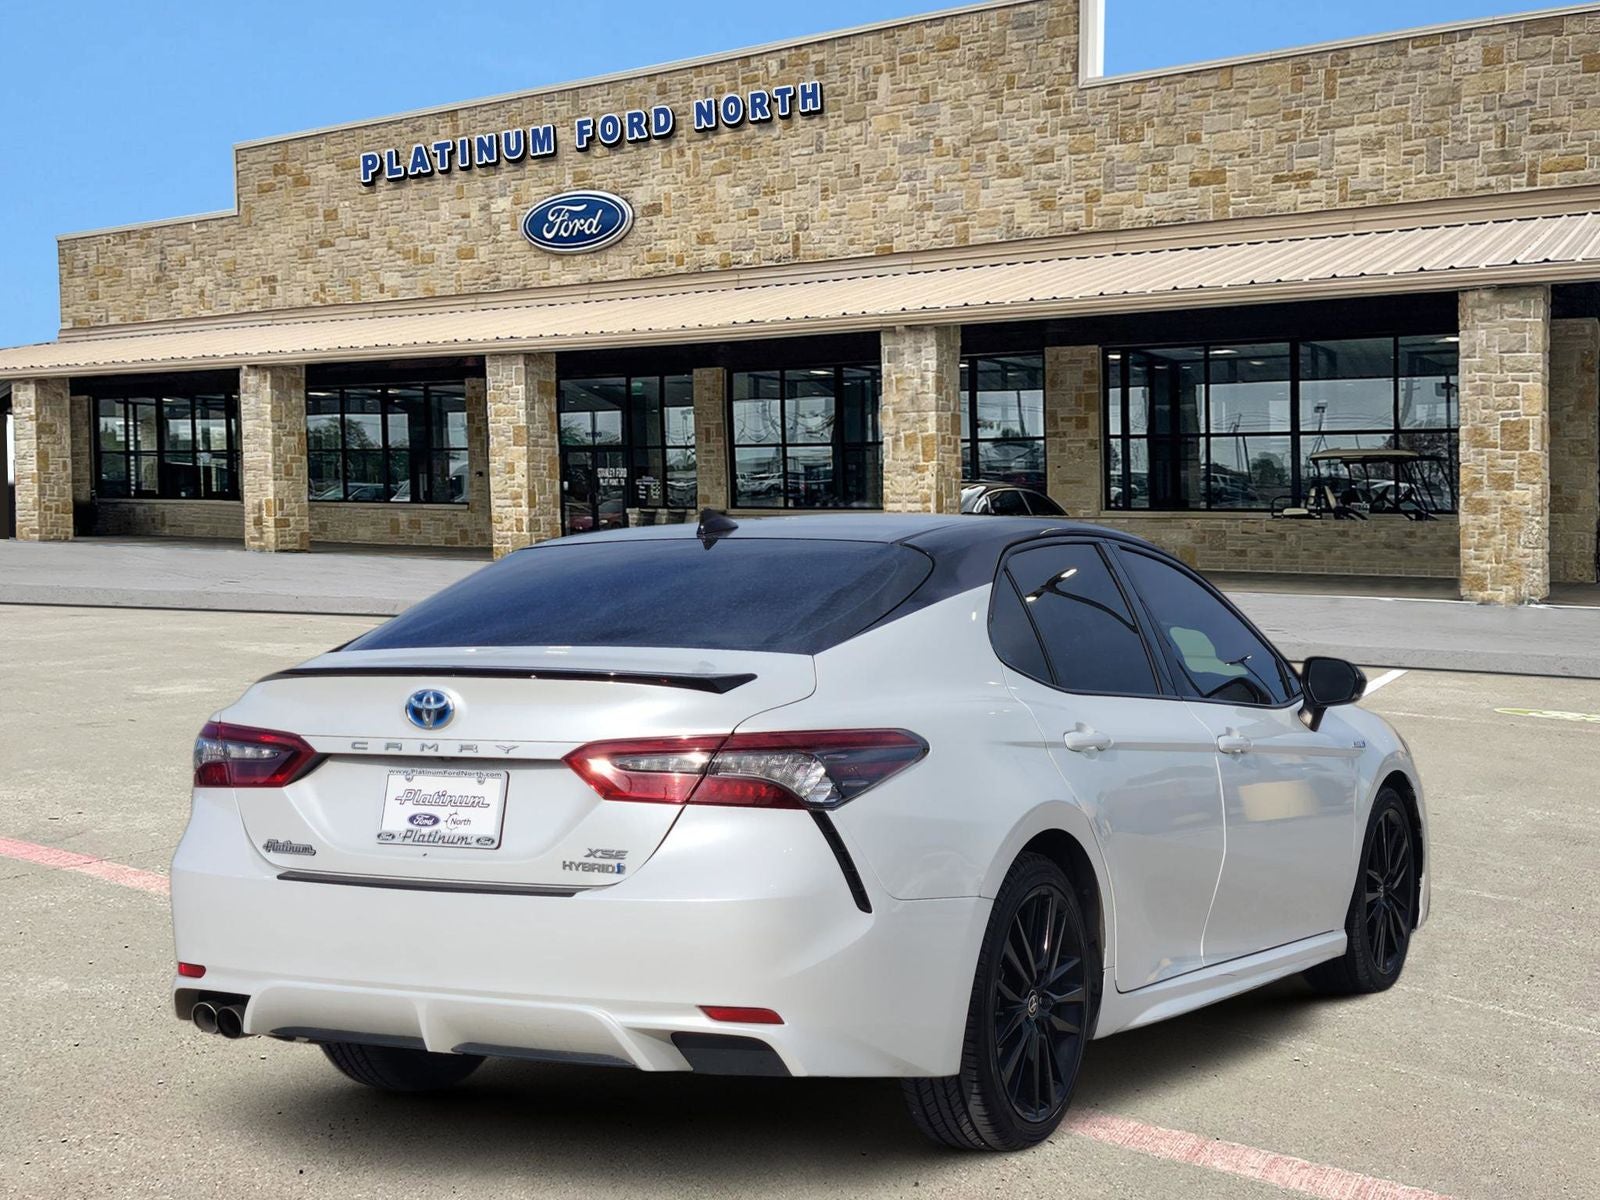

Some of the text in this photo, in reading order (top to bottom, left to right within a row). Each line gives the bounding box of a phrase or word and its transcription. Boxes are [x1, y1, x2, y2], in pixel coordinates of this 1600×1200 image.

[359, 80, 824, 186] PLATINUM FORD NORTH
[541, 203, 603, 240] Ford
[350, 741, 520, 754] CAMRY
[388, 768, 502, 778] www.PlatinumFordNorth.com
[395, 788, 491, 808] Platinum
[413, 814, 472, 827] Ford North
[402, 829, 473, 845] Platinum
[583, 847, 629, 860] XSE
[561, 860, 616, 874] HYBRID
